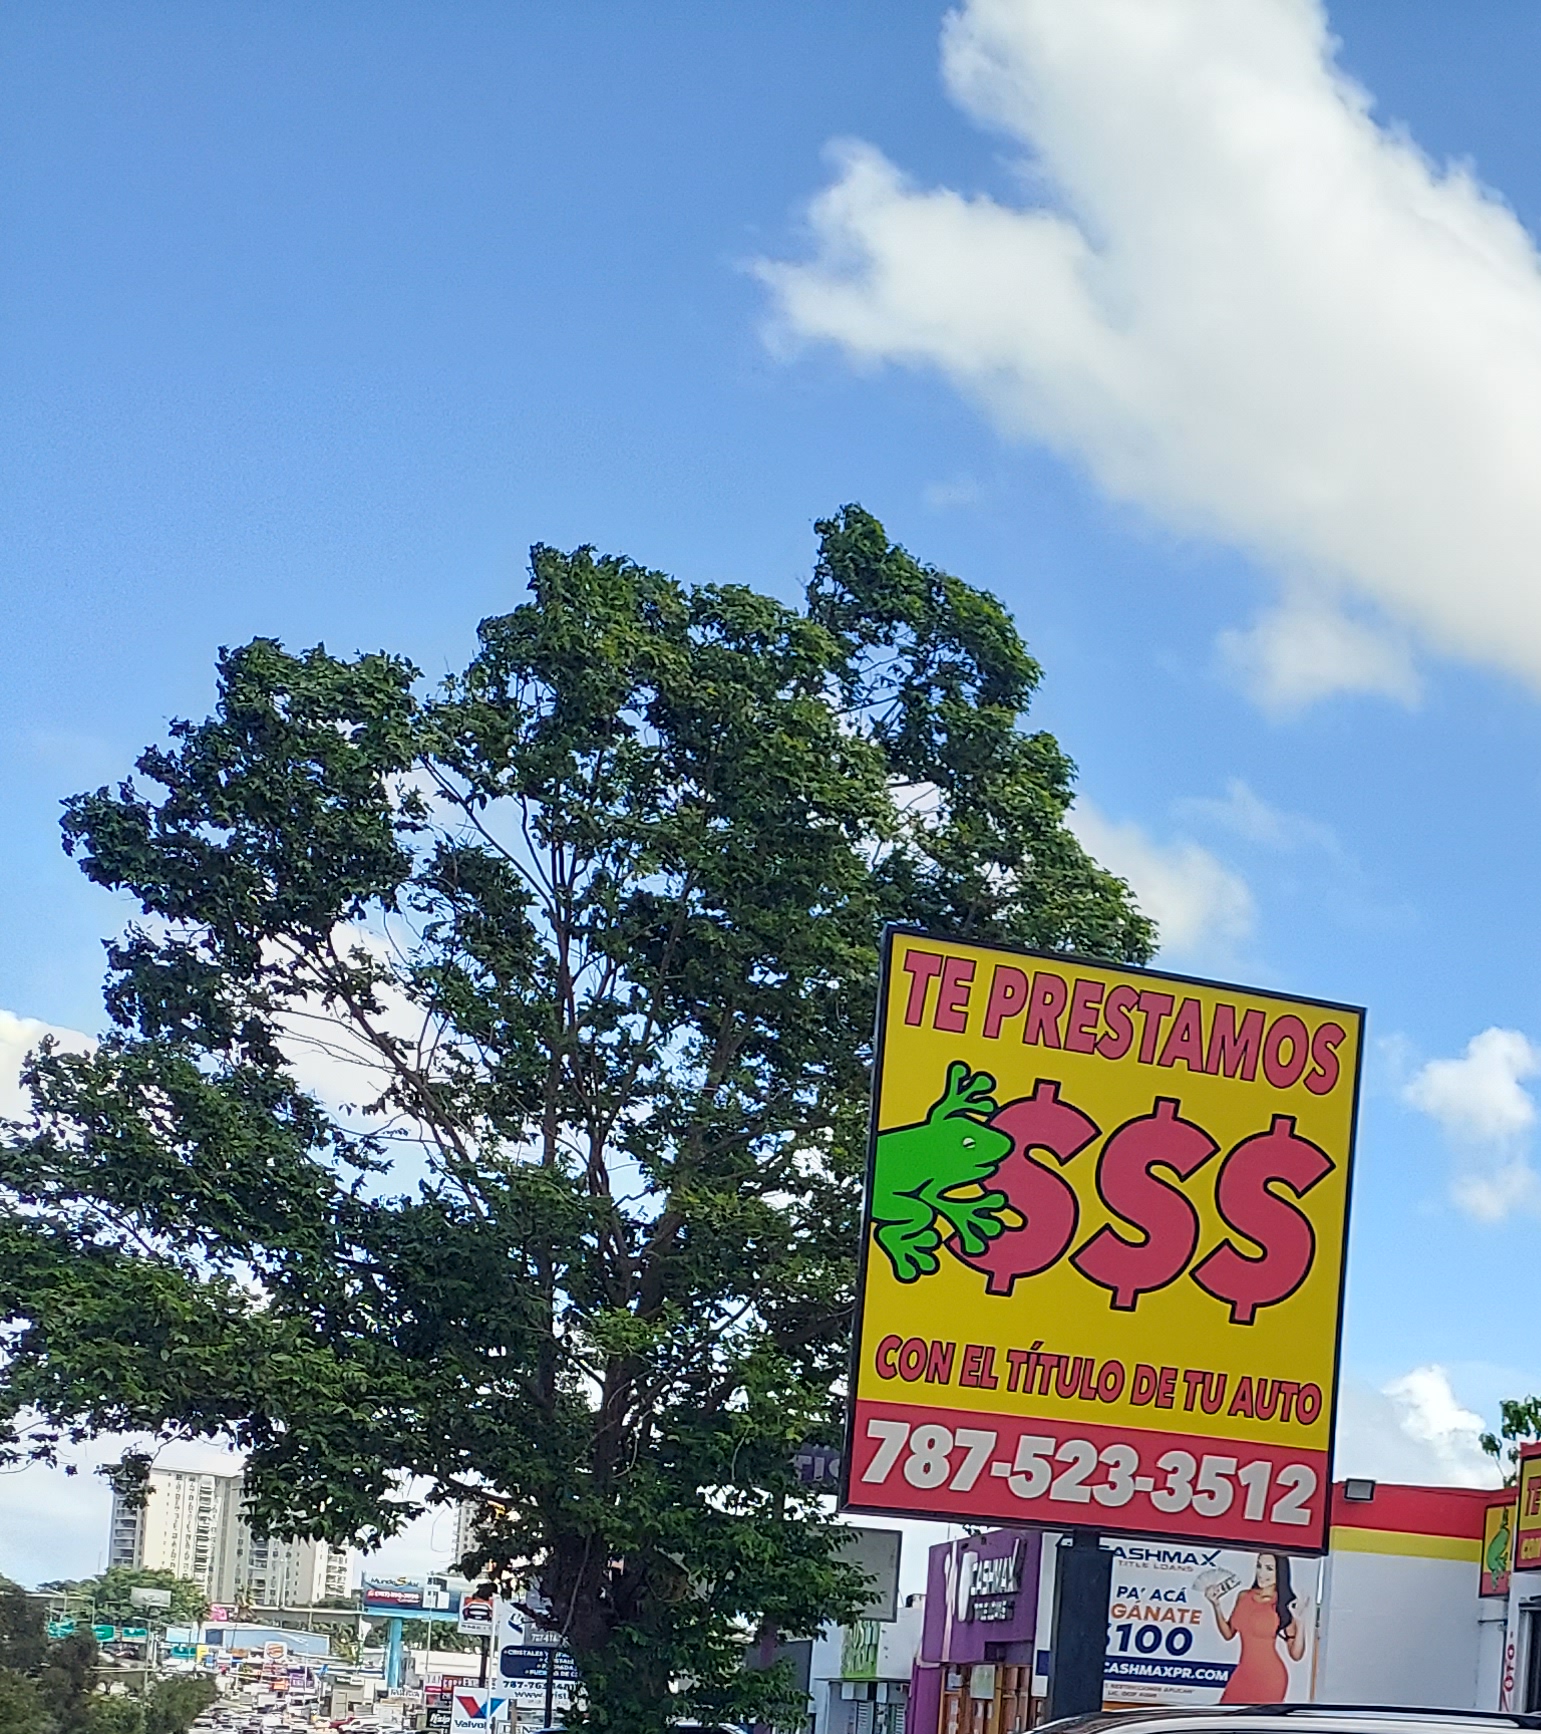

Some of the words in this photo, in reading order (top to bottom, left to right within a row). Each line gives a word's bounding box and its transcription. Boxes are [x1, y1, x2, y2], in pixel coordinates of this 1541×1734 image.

[902, 949, 977, 1034] TE
[982, 964, 1347, 1096] PRESTAMOS
[875, 1334, 955, 1385] CON
[959, 1344, 999, 1390] EL
[1006, 1341, 1126, 1403] TÍTULO
[1129, 1363, 1177, 1409] DE
[1183, 1369, 1227, 1414] TU
[1227, 1376, 1323, 1426] AUTO
[861, 1418, 1318, 1526] 787-523-3512
[1118, 1560, 1149, 1569] TITLE
[1153, 1562, 1195, 1573] LOANS
[1150, 1586, 1187, 1603] ACÁ
[1111, 1600, 1202, 1624] GÁNATE
